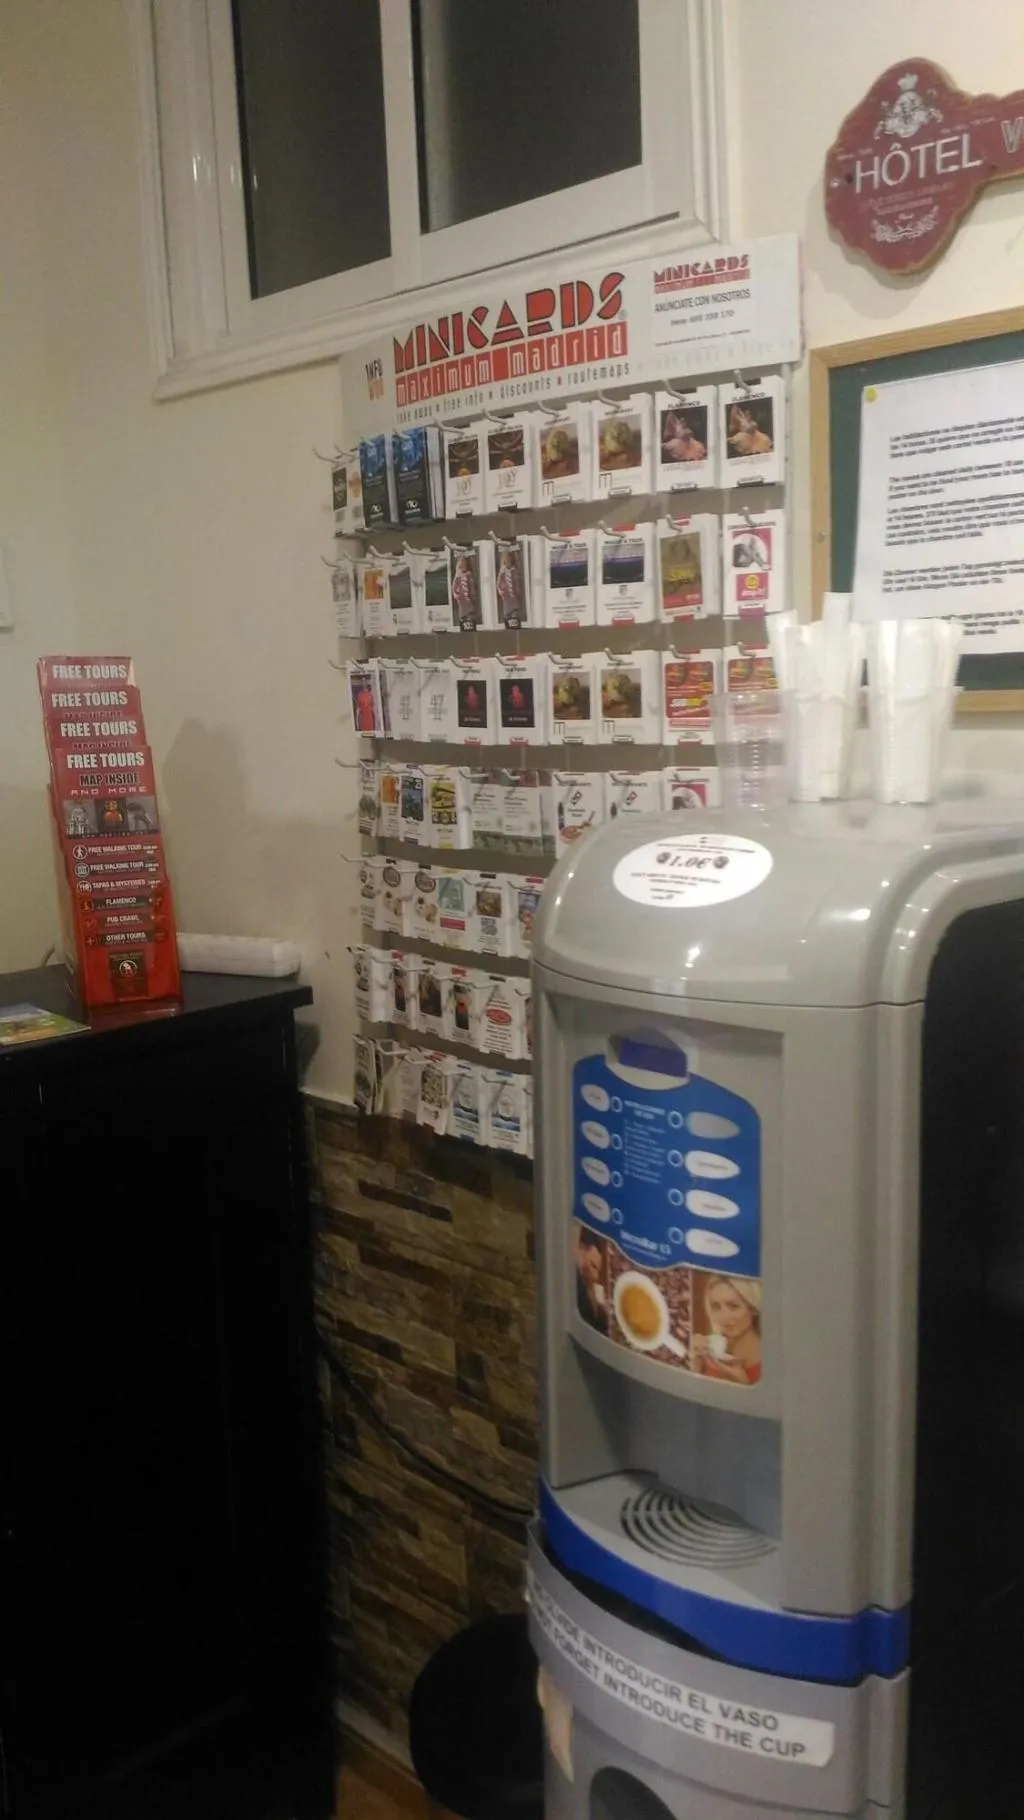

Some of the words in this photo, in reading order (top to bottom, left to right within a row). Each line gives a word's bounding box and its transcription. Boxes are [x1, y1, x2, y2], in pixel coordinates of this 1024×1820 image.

[855, 133, 983, 194] HÔTEL
[653, 254, 750, 283] MINICARDS
[393, 271, 625, 373] MINICARDS
[396, 359, 490, 407] maximum
[512, 324, 622, 375] madrid
[52, 665, 81, 679] FREE
[84, 664, 127, 679] TOURS
[51, 693, 82, 708] FREE
[84, 690, 128, 706] TOURS
[60, 722, 91, 737] FREE
[92, 720, 137, 737] TOURS
[66, 754, 98, 769] FREE
[100, 752, 145, 768] TOURS
[80, 774, 103, 786] MAP
[106, 772, 139, 785] INSIDE
[108, 786, 147, 795] MORE
[105, 897, 137, 905] FLAMENCO
[106, 934, 126, 942] OTHER
[583, 1634, 681, 1703] INTRODUCIR
[687, 1690, 711, 1715] EL
[718, 1702, 779, 1731] VASO
[604, 1673, 706, 1735] INTRODUCE
[713, 1722, 753, 1749] THE
[759, 1736, 806, 1758] CUP
